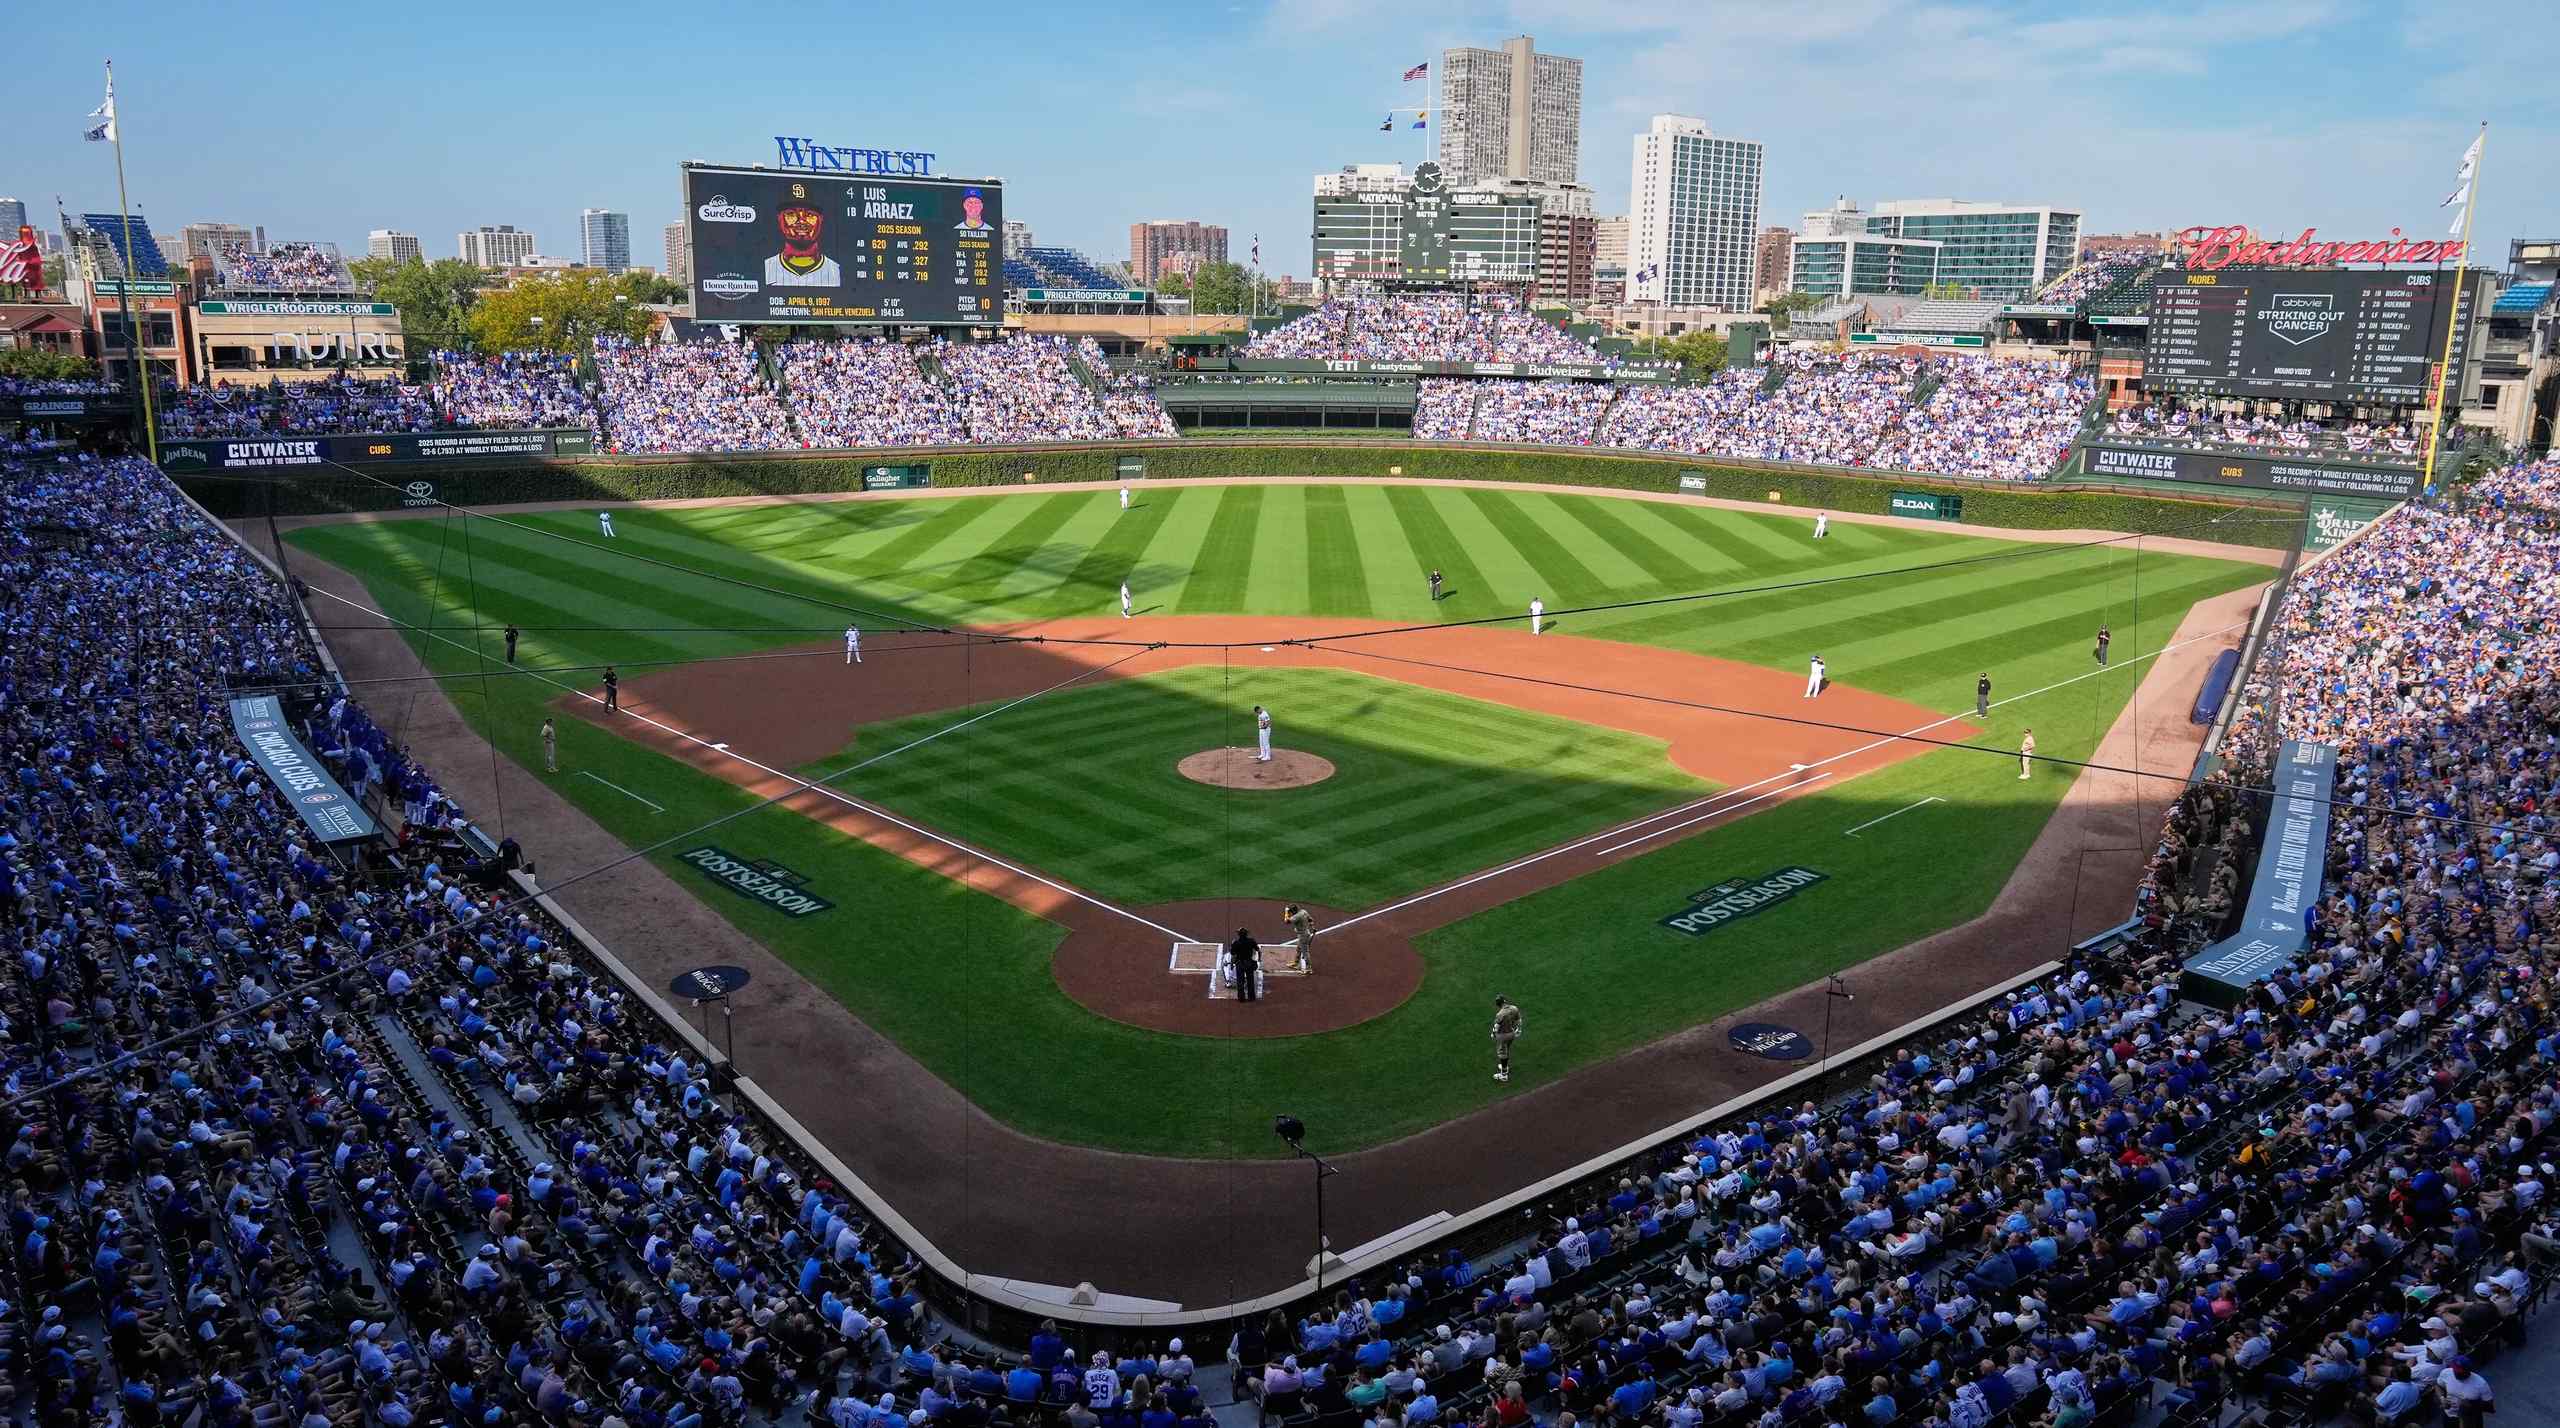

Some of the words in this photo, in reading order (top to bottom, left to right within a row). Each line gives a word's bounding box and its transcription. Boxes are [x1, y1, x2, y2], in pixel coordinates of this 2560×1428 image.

[774, 136, 936, 176] WINTRUST
[846, 187, 854, 200] 4
[863, 187, 887, 201] LUIS
[1358, 193, 1404, 204] NATIONAL
[1452, 194, 1498, 204] AMERICAN
[704, 206, 752, 220] SureCrisp
[847, 206, 857, 217] 1B
[864, 201, 914, 220] ARRAEZ
[877, 224, 895, 234] 2025
[895, 225, 922, 235] SEASON
[872, 239, 887, 249] 620
[896, 240, 908, 249] AVG
[912, 240, 929, 251] .292
[1408, 237, 1416, 248] 2
[1436, 237, 1443, 248] 2
[2179, 224, 2469, 270] Budweiser
[913, 256, 929, 266] .327
[876, 270, 884, 281] 61
[914, 271, 929, 281] .719
[2187, 275, 2217, 285] PADRES
[2406, 275, 2432, 286] CUBS
[958, 296, 976, 304] PITCH
[1043, 289, 1130, 300] WRIGLEYROOFTOPS.COM
[788, 296, 807, 306] APRIL
[981, 298, 990, 310] 10
[2281, 299, 2323, 307] abbvie
[225, 302, 373, 314] WRIGLEYROOFTOPS.COM
[769, 306, 811, 317] HOMETOWN:
[812, 307, 824, 317] SAN
[844, 307, 876, 317] VENEZUELA
[880, 308, 892, 317] 194
[892, 308, 905, 318] LBS
[957, 304, 977, 312] COUNT
[2257, 310, 2317, 321] STRIKING
[2318, 311, 2345, 321] OUT
[2274, 320, 2324, 331] CANCER
[1325, 360, 1359, 372] YETI
[1376, 362, 1424, 372] tastytrade
[1527, 364, 1590, 377] Budweiser
[2273, 367, 2294, 375] MOUND
[2294, 368, 2312, 376] VISITS
[1615, 368, 1657, 379] Advocate
[23, 401, 85, 411] GRAINGER
[418, 439, 434, 447] 2025
[434, 439, 458, 447] RECORD
[458, 438, 467, 446] AT
[467, 438, 493, 447] WRIGLEY
[493, 437, 511, 445] FIELD:
[227, 440, 316, 459] CUTWATER
[369, 445, 392, 456] CUBS
[464, 446, 490, 454] WRIGLEY
[490, 445, 522, 453] FOLLOWING
[528, 444, 543, 452] LOSS
[163, 449, 182, 464] JIM
[181, 446, 208, 463] BEAM
[2099, 451, 2175, 470] CUTWATER
[224, 458, 248, 467] OFFICIAL
[274, 457, 285, 465] THE
[285, 457, 307, 465] CHICAGO
[2094, 465, 2113, 473] OFFICIAL
[2221, 466, 2243, 478] CUBS
[2270, 466, 2287, 474] 2025
[2322, 470, 2351, 480] WRIGLEY
[2351, 473, 2372, 482] FIELD:
[2372, 475, 2392, 483] 50-29
[866, 475, 901, 483] Gallagher
[2317, 480, 2346, 489] WRIGLEY
[2346, 482, 2384, 493] FOLLOWING
[2390, 486, 2409, 494] LOSS
[404, 498, 438, 507] TOYOTA
[251, 731, 302, 767] CHICAGO
[279, 765, 327, 794] CUBS
[684, 848, 825, 914] POSTSEASON
[1669, 868, 1821, 932] POSTSEASON
[2271, 888, 2301, 914] Welcome
[2197, 939, 2274, 975] WINTRUST
[1090, 1384, 1109, 1401] 29
